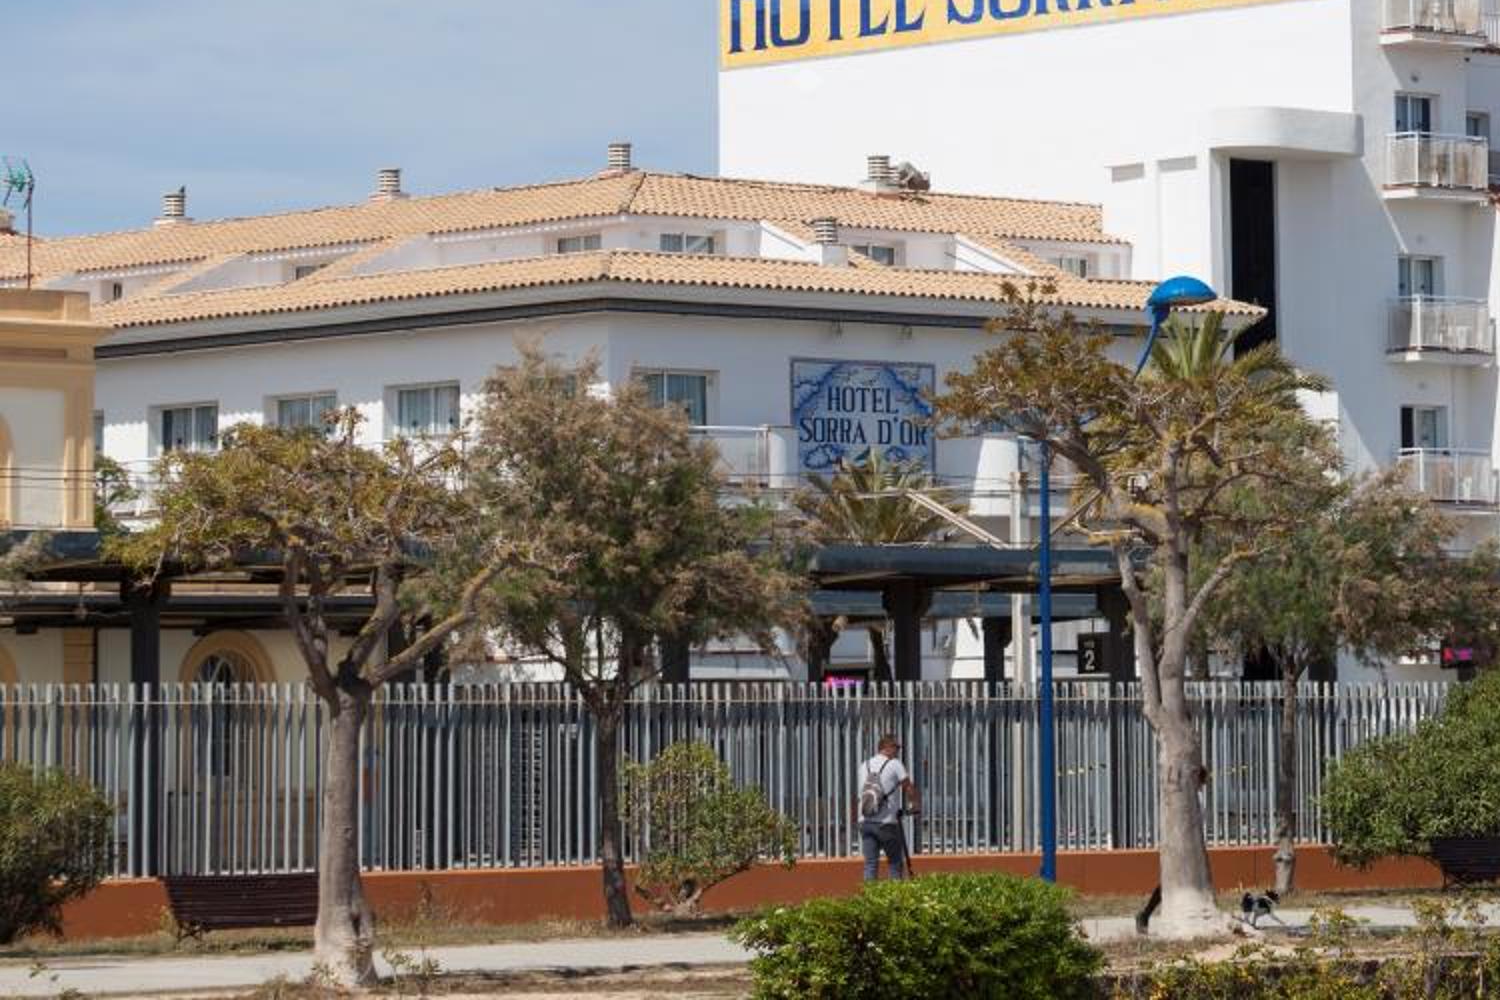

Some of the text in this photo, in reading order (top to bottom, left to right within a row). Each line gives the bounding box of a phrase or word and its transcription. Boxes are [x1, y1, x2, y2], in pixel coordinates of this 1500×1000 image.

[827, 386, 899, 414] HOTEL
[800, 417, 927, 446] SORRA D'OR
[1084, 649, 1096, 671] 2
